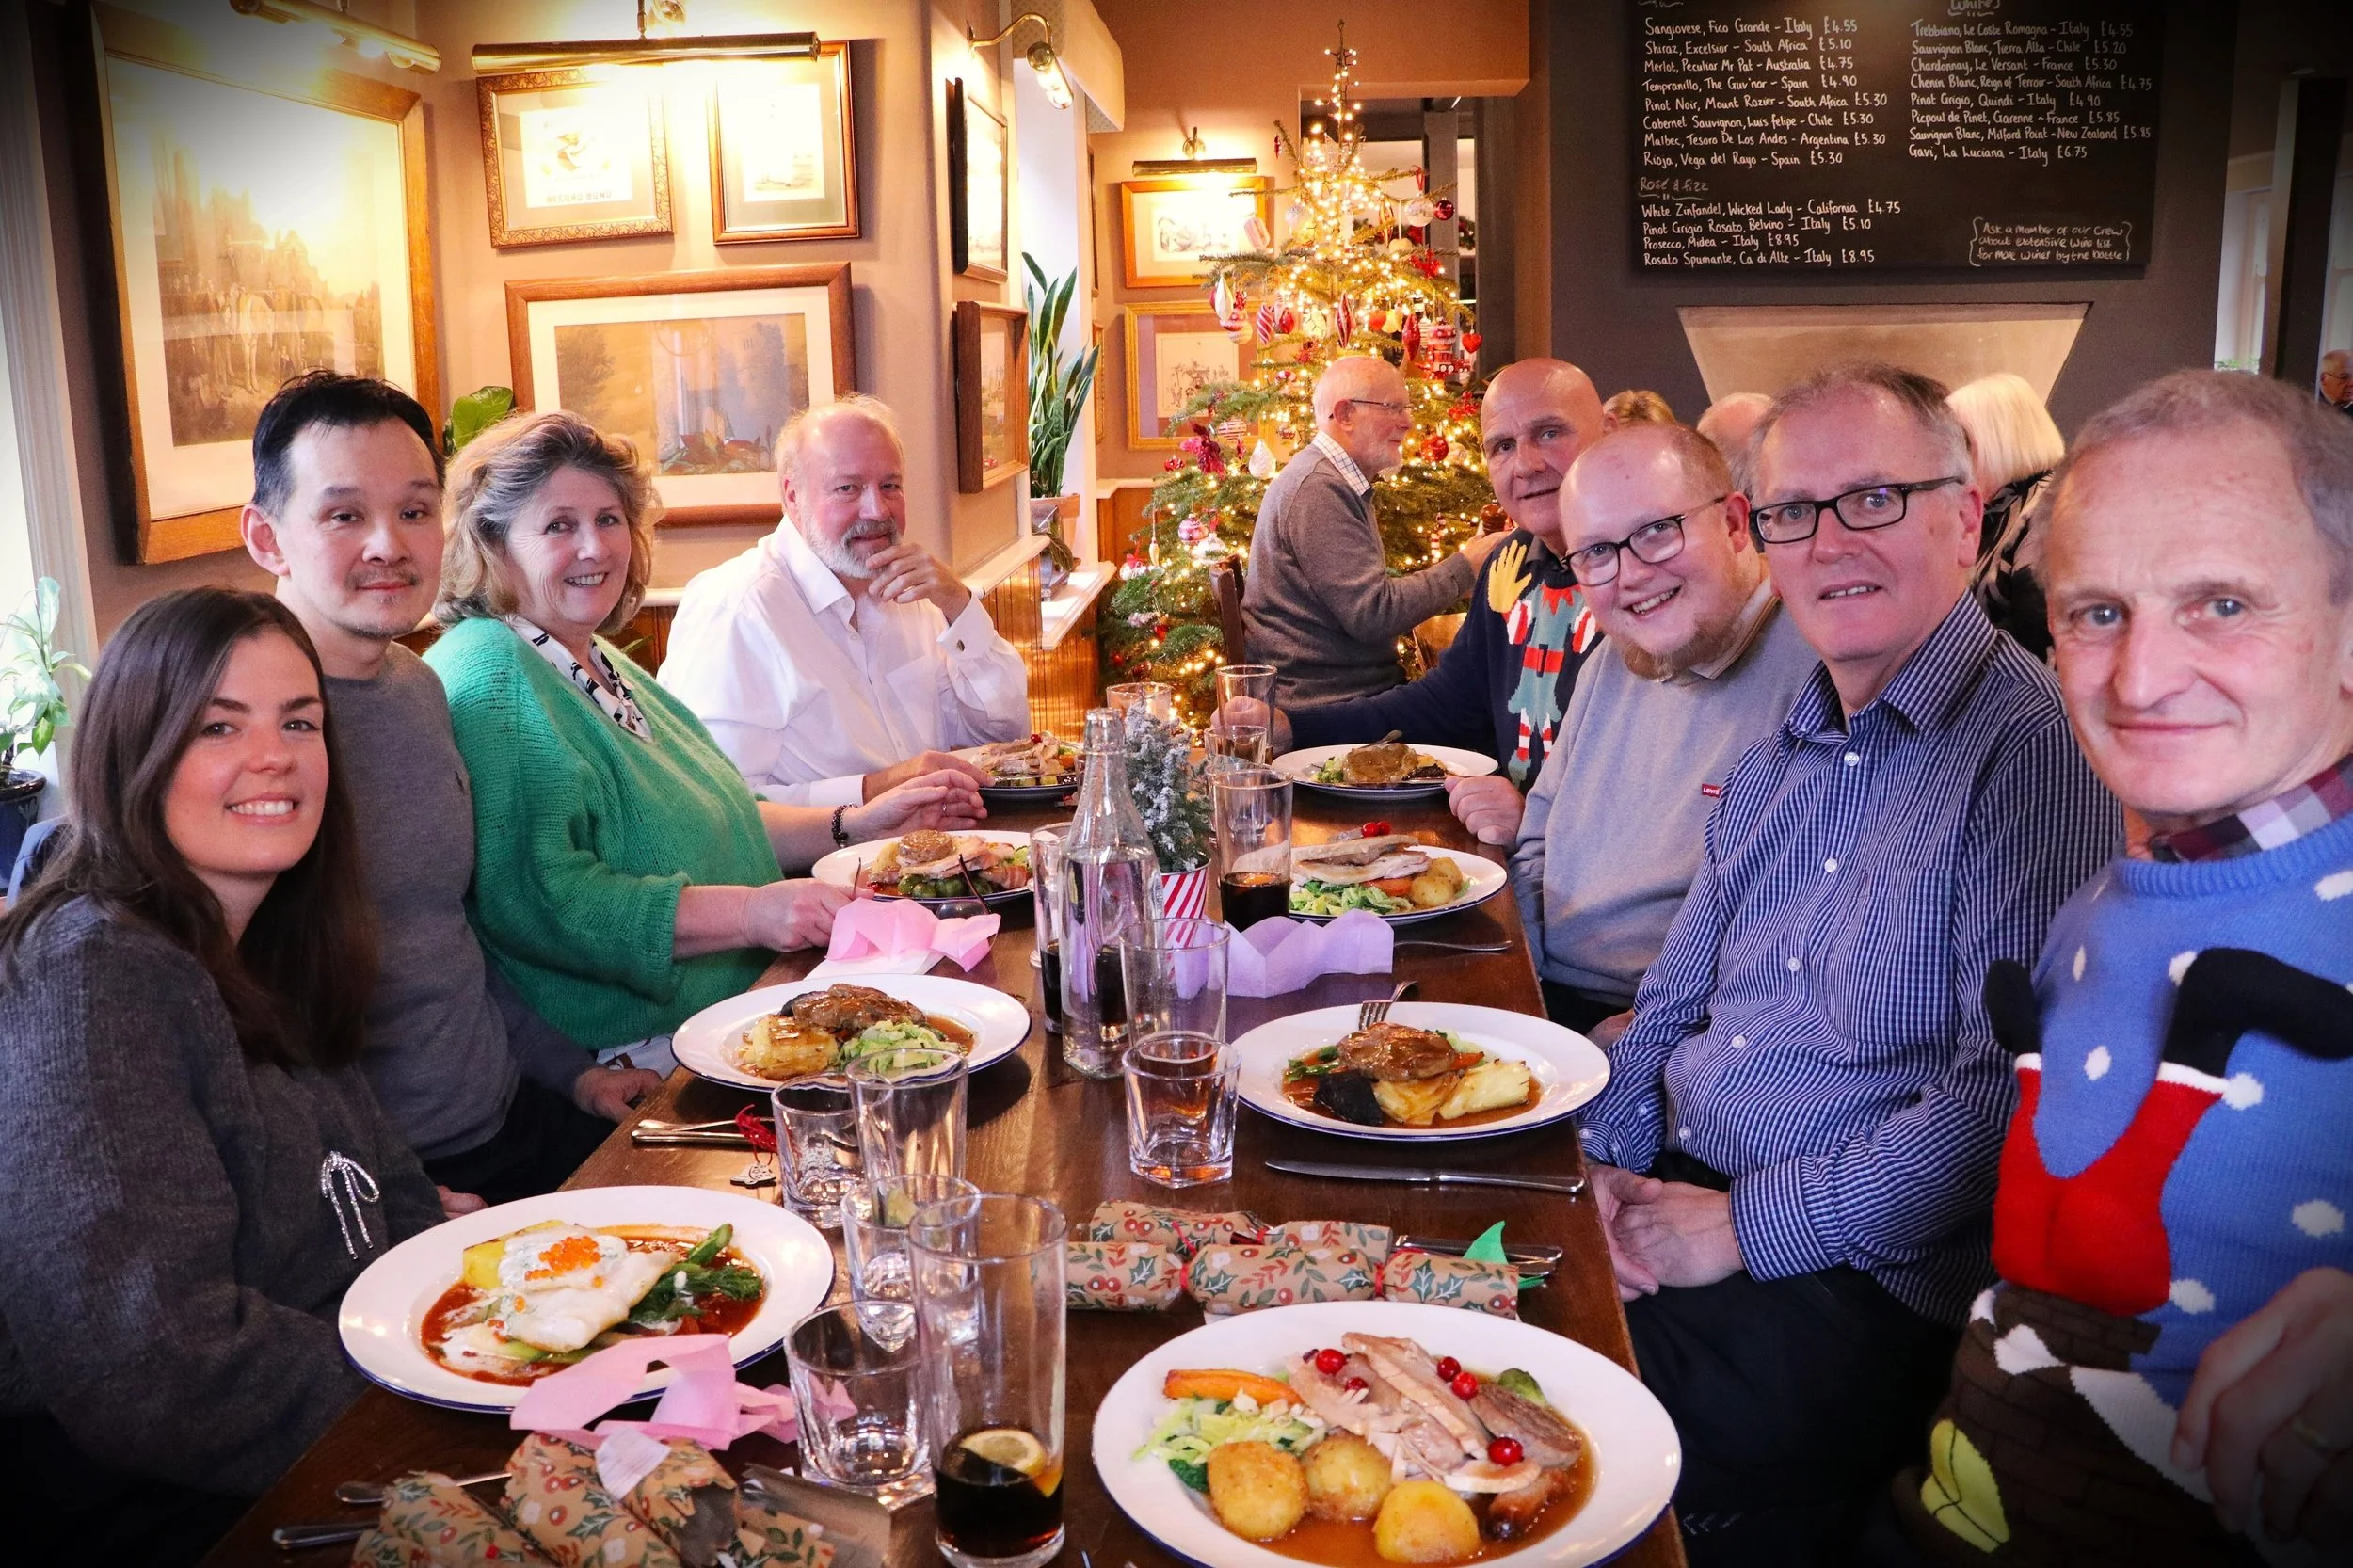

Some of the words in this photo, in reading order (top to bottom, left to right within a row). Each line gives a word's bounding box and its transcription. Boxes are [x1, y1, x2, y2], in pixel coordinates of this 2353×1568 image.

[1645, 17, 1706, 40] Sangiovese,
[1708, 20, 1729, 33] Fico
[1734, 18, 1770, 33] Grande
[1784, 17, 1813, 40] Italy
[1823, 15, 1858, 34] £4.55
[1963, 24, 1975, 36] Le
[2004, 20, 2049, 40] Romagna
[2058, 21, 2089, 42] Italy
[1645, 40, 1683, 56] Shiraz,
[1685, 41, 1729, 55] Excelsior
[1744, 39, 1774, 53] South
[1778, 38, 1808, 53] Africa
[1818, 36, 1852, 51] £5.10
[1912, 40, 1963, 60] Sauvignon
[1993, 39, 2023, 55] Tierra
[2025, 40, 2046, 54] Alta
[2057, 40, 2081, 53] Chile
[1644, 59, 1679, 74] Merlot,
[1681, 57, 1718, 72] Peculiar
[1721, 59, 1734, 72] Mr
[1737, 57, 1754, 72] Pat
[1766, 57, 1811, 72] Australia
[1819, 55, 1853, 71] £4.75
[1975, 57, 1988, 71] Le
[1991, 57, 2028, 71] Versant
[2041, 56, 2074, 71] France
[2085, 56, 2118, 71] £5.30
[1641, 78, 1702, 94] Tempranillo,
[1704, 77, 1722, 90] The
[1781, 76, 1809, 92] Spain
[1821, 74, 1857, 88] £4.90
[1911, 73, 1945, 88] Chenin
[1979, 75, 2003, 92] Reign
[2003, 76, 2012, 89] of
[2015, 73, 2046, 88] Terroir
[2055, 73, 2082, 88] South
[2084, 75, 2112, 89] Africa
[2121, 74, 2153, 91] £4.75
[1645, 97, 1671, 112] Pinot
[1675, 97, 1701, 112] Noir,
[1705, 96, 1739, 110] Mount
[1744, 94, 1776, 107] Rozier
[1787, 95, 1817, 107] South
[1818, 94, 1849, 109] Africa
[1855, 91, 1888, 106] £5.30
[1911, 92, 1937, 106] Pinot
[2026, 93, 2057, 113] Italy
[2069, 92, 2101, 107] £4.90
[1643, 116, 1688, 130] Cabernet
[1691, 115, 1746, 132] Sauvignon,
[1747, 116, 1769, 127] Luis
[1808, 113, 1833, 126] Chile
[1843, 111, 1874, 126] £5.30
[1911, 109, 1945, 127] Picpoul
[1948, 111, 1960, 123] de
[1993, 110, 2033, 123] Garenne
[2046, 112, 2079, 124] France
[1644, 133, 1685, 149] Malbec,
[1686, 133, 1718, 146] Tesoro
[1721, 131, 1734, 144] De
[1738, 134, 1754, 146] Los
[1760, 132, 1788, 144] Andes
[1800, 132, 1849, 150] Argentina
[1854, 132, 1886, 146] £5.30
[1910, 127, 1954, 145] Sauvignon
[1987, 127, 2021, 141] Milford
[2025, 126, 2048, 139] Point
[2057, 127, 2078, 139] New
[2081, 126, 2118, 140] Zealand
[1643, 151, 1678, 169] Rioja,
[1680, 153, 1706, 169] Vega
[1710, 152, 1726, 165] del
[1732, 151, 1757, 169] Rayo
[1771, 152, 1801, 169] Spain
[1810, 151, 1843, 166] £5.30
[1942, 144, 1957, 158] La
[1962, 146, 2005, 158] Luciana
[2019, 145, 2049, 166] Italy
[1641, 204, 1672, 218] White
[1727, 202, 1763, 216] Wicked
[1767, 201, 1793, 221] Lady
[1808, 199, 1858, 215] California
[1643, 222, 1669, 235] Pinot
[1672, 221, 1703, 238] Grigio
[1748, 217, 1784, 231] Belvino
[1801, 216, 1831, 235] Italy
[1842, 216, 1872, 231] £5.10
[2072, 226, 2091, 234] our
[1643, 236, 1685, 250] Prosecco,
[1688, 236, 1717, 248] Midea
[1732, 235, 1759, 251] Italy
[1643, 252, 1678, 266] Rosato
[1683, 251, 1737, 268] Spumante,
[1739, 250, 1754, 264] Ca
[1757, 252, 1767, 264] di
[1769, 250, 1789, 264] Alte
[1803, 248, 1832, 267] Italy
[1841, 248, 1875, 264] £8.95
[2056, 250, 2070, 264] by
